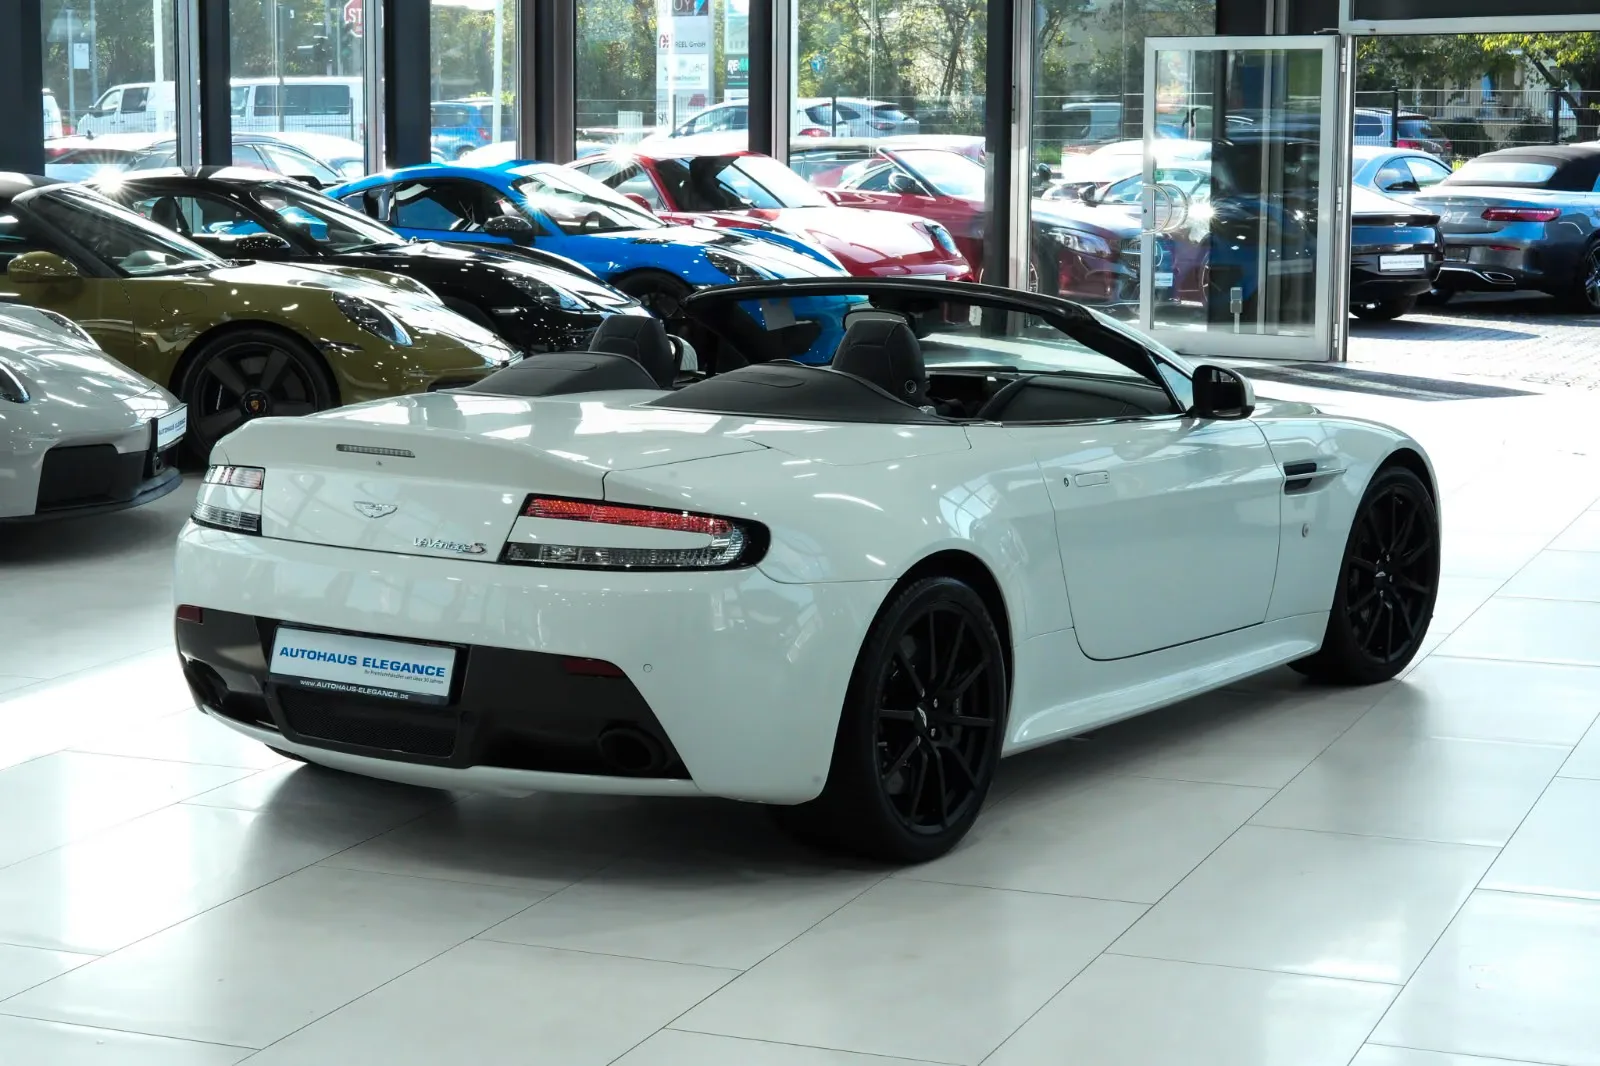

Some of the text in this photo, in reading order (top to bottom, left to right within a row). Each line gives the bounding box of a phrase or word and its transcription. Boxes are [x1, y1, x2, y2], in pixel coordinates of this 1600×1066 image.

[348, 7, 363, 24] ST
[279, 647, 446, 678] AUTOHAUS ELEGANCE
